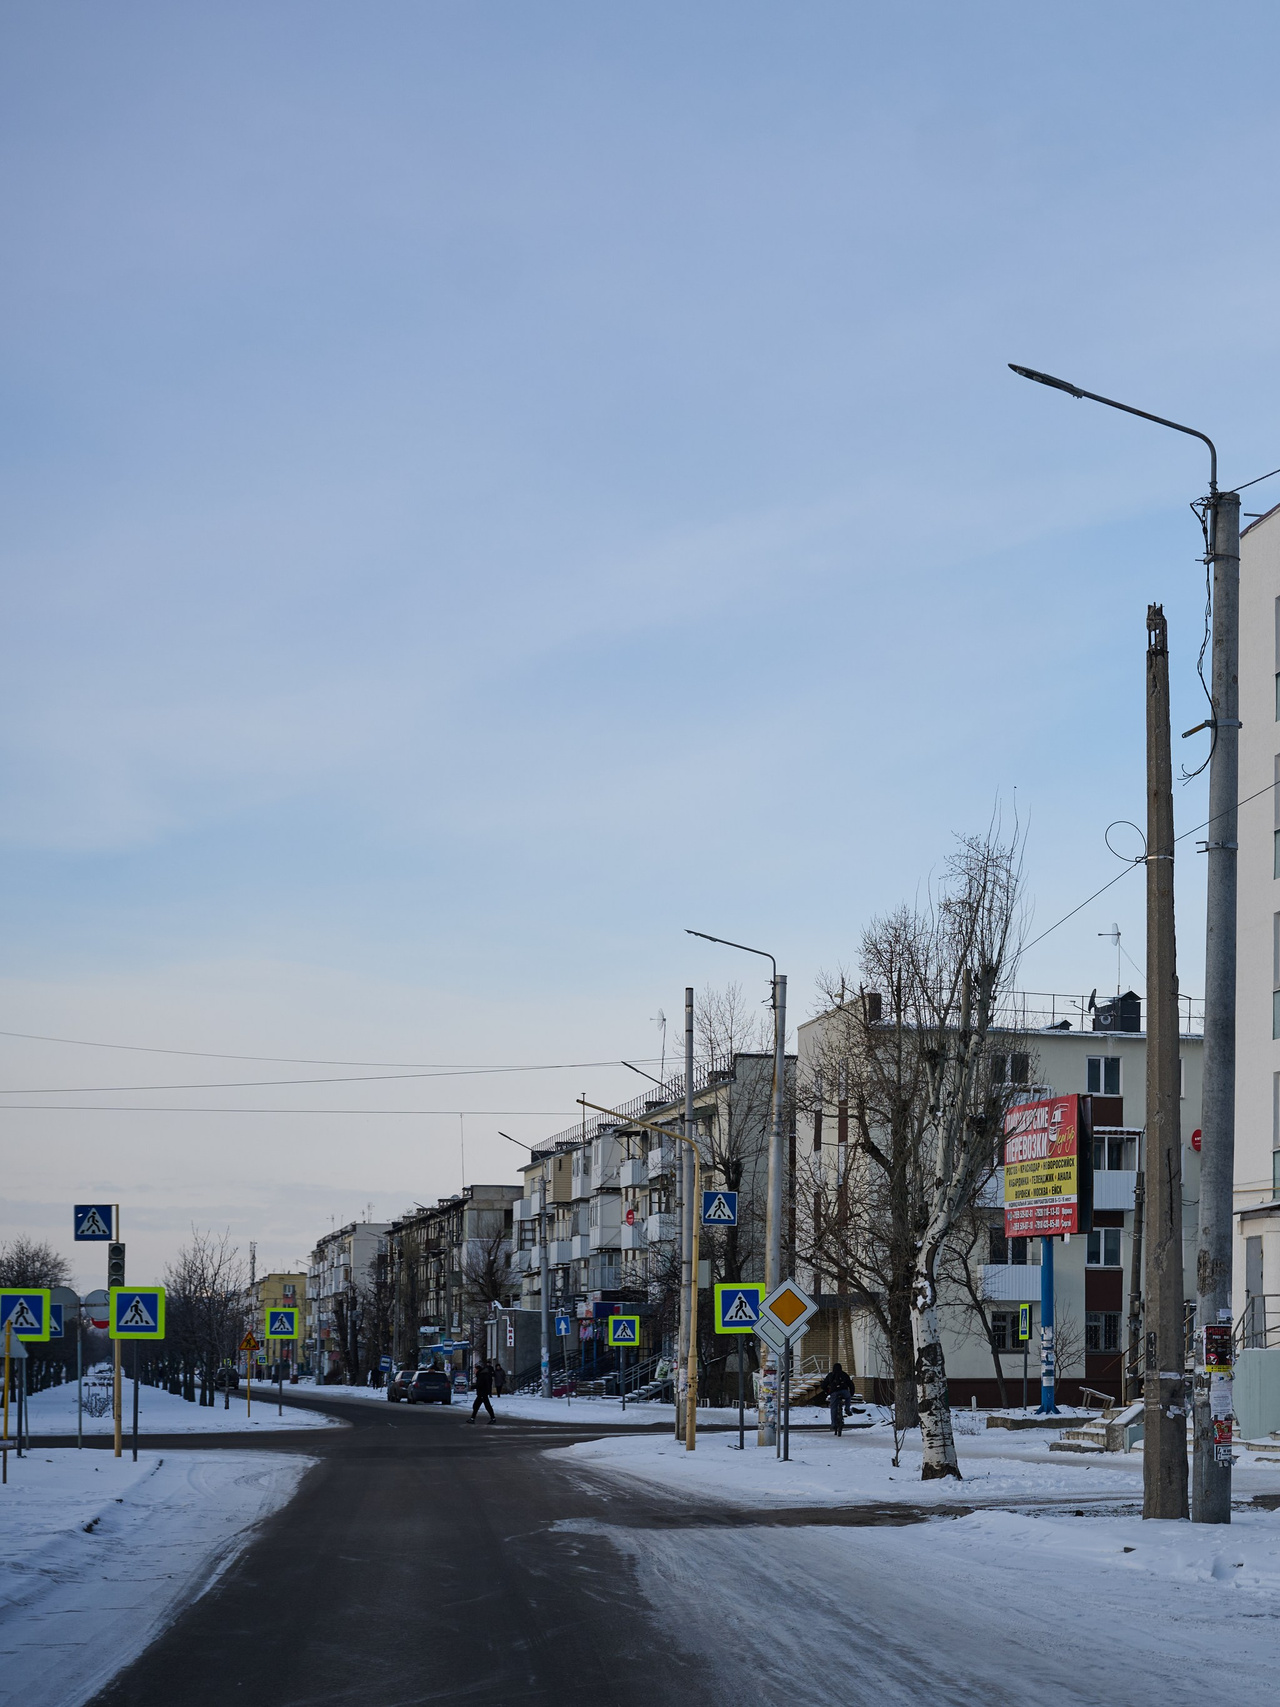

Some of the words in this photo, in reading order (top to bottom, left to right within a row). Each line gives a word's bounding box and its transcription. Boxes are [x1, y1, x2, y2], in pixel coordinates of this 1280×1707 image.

[1006, 1132, 1048, 1163] ПЕРЕВОЗКИ
[1020, 1162, 1040, 1173] КРАСНОДАР
[1043, 1157, 1075, 1170] НОВОРОССИЙСК
[1031, 1173, 1054, 1184] ГЕЛЕНДЖИК
[1057, 1171, 1072, 1181] АНАПА
[1015, 1188, 1030, 1199] ВОРОНЕЖ
[1033, 1186, 1049, 1197] МОСКВА
[1051, 1184, 1062, 1195] ЕЙСК
